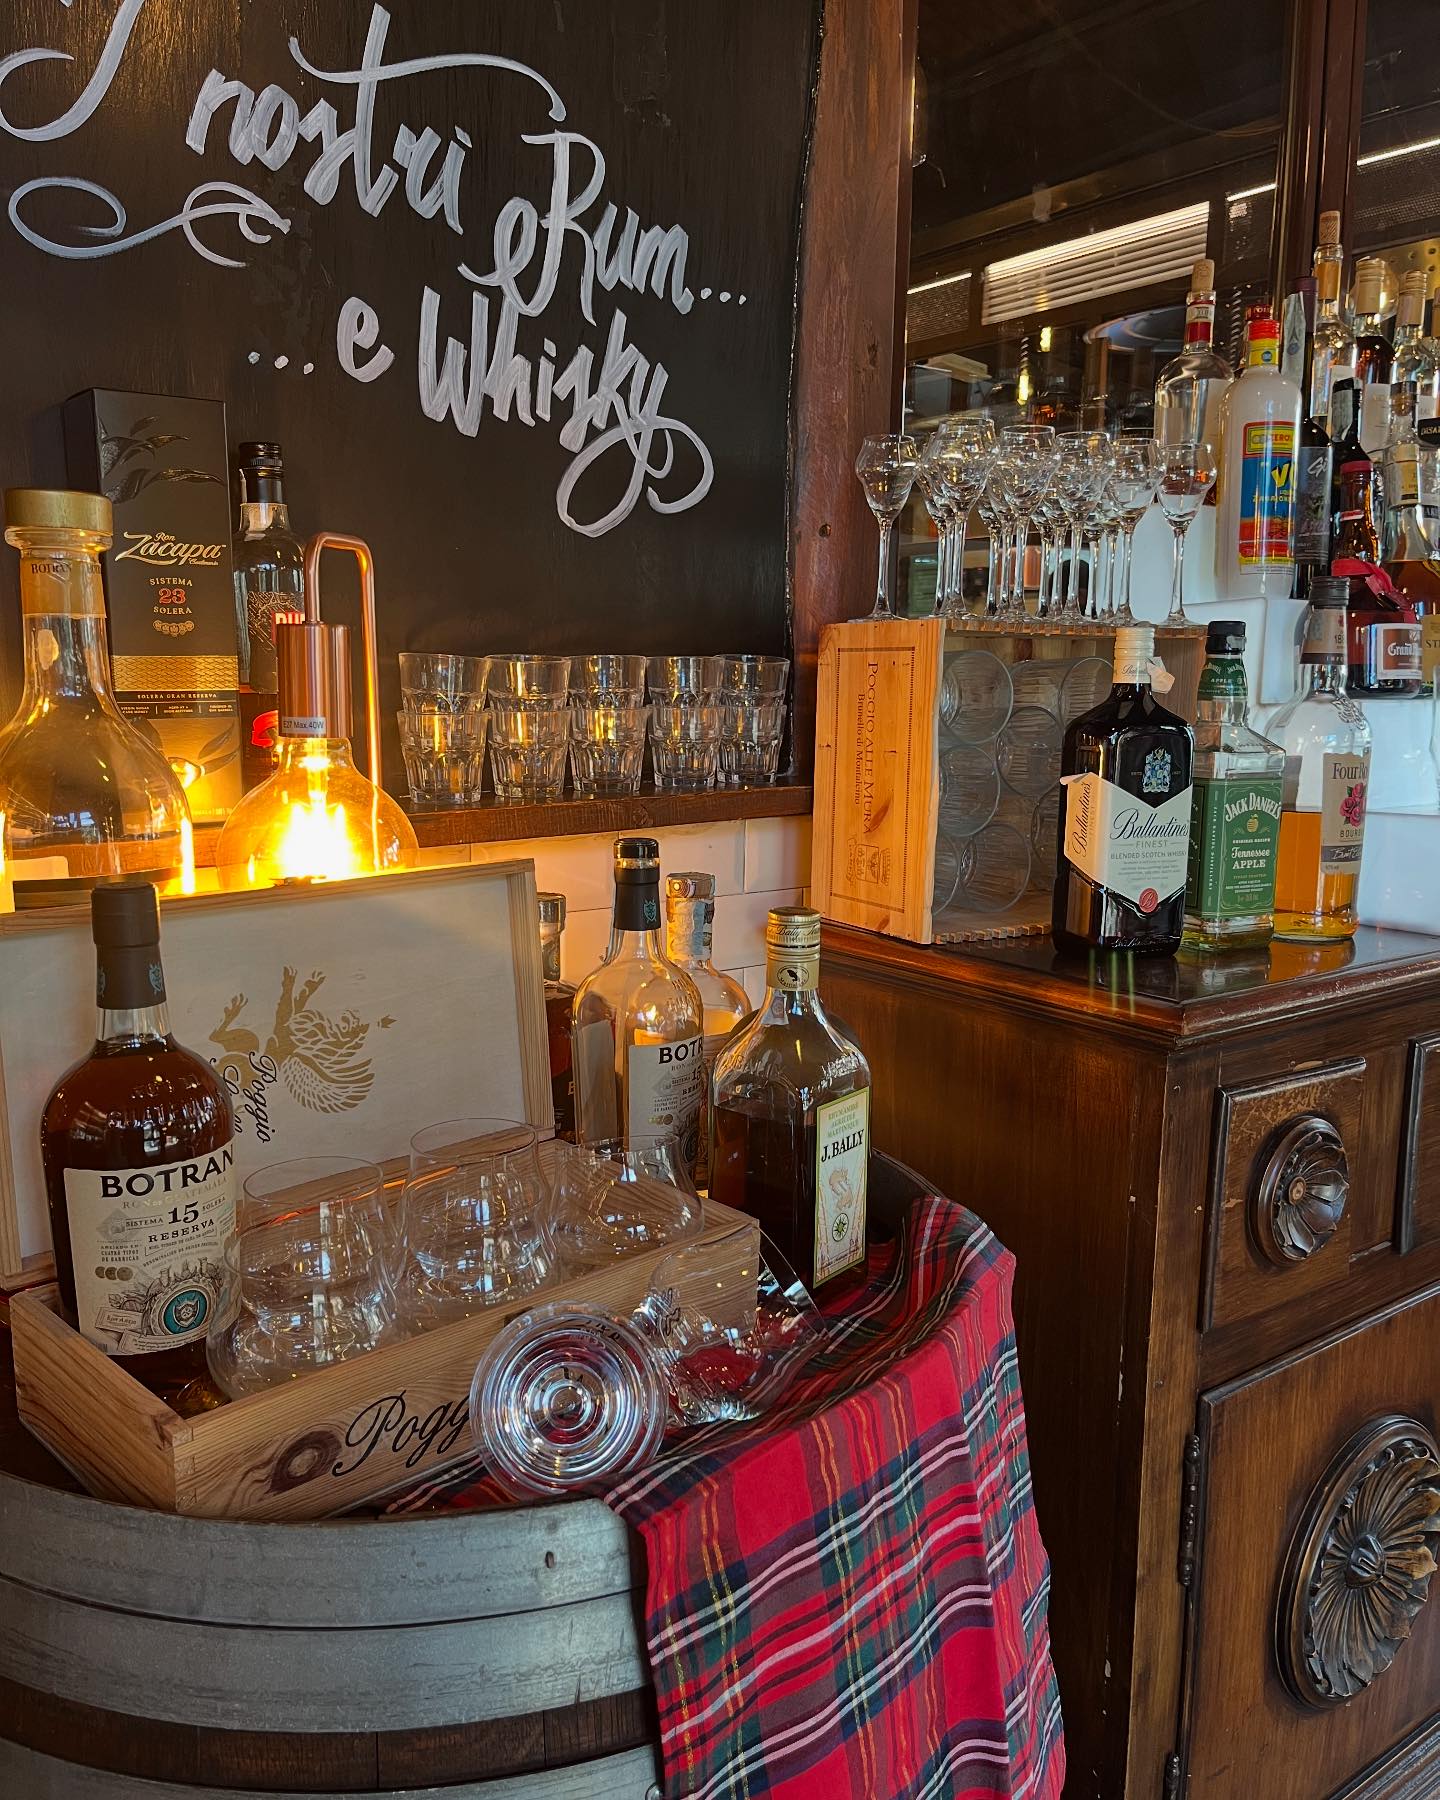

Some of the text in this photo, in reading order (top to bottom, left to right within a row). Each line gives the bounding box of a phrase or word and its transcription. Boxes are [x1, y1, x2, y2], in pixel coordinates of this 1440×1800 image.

[185, 3, 566, 235] nostri
[418, 285, 714, 537] Whisky
[114, 531, 222, 566] Zacapa
[155, 532, 176, 542] Ron
[150, 577, 193, 587] SISTEMA
[158, 588, 187, 604] 23
[153, 606, 193, 615] SOLERA
[854, 693, 866, 805] Brunello di Montalcino
[863, 662, 879, 834] POGGIO ALLE MURA
[1332, 762, 1357, 780] Four
[1224, 798, 1249, 822] JACK
[1142, 850, 1166, 858] SCOTCH
[1231, 846, 1270, 859] Tennessee
[1232, 859, 1266, 869] APPLE
[243, 1051, 278, 1144] Poggio
[99, 1143, 233, 1198] BOTRAN
[125, 1218, 164, 1228] SISTEMA
[168, 1201, 199, 1225] 15
[148, 1218, 215, 1243] RESERVA
